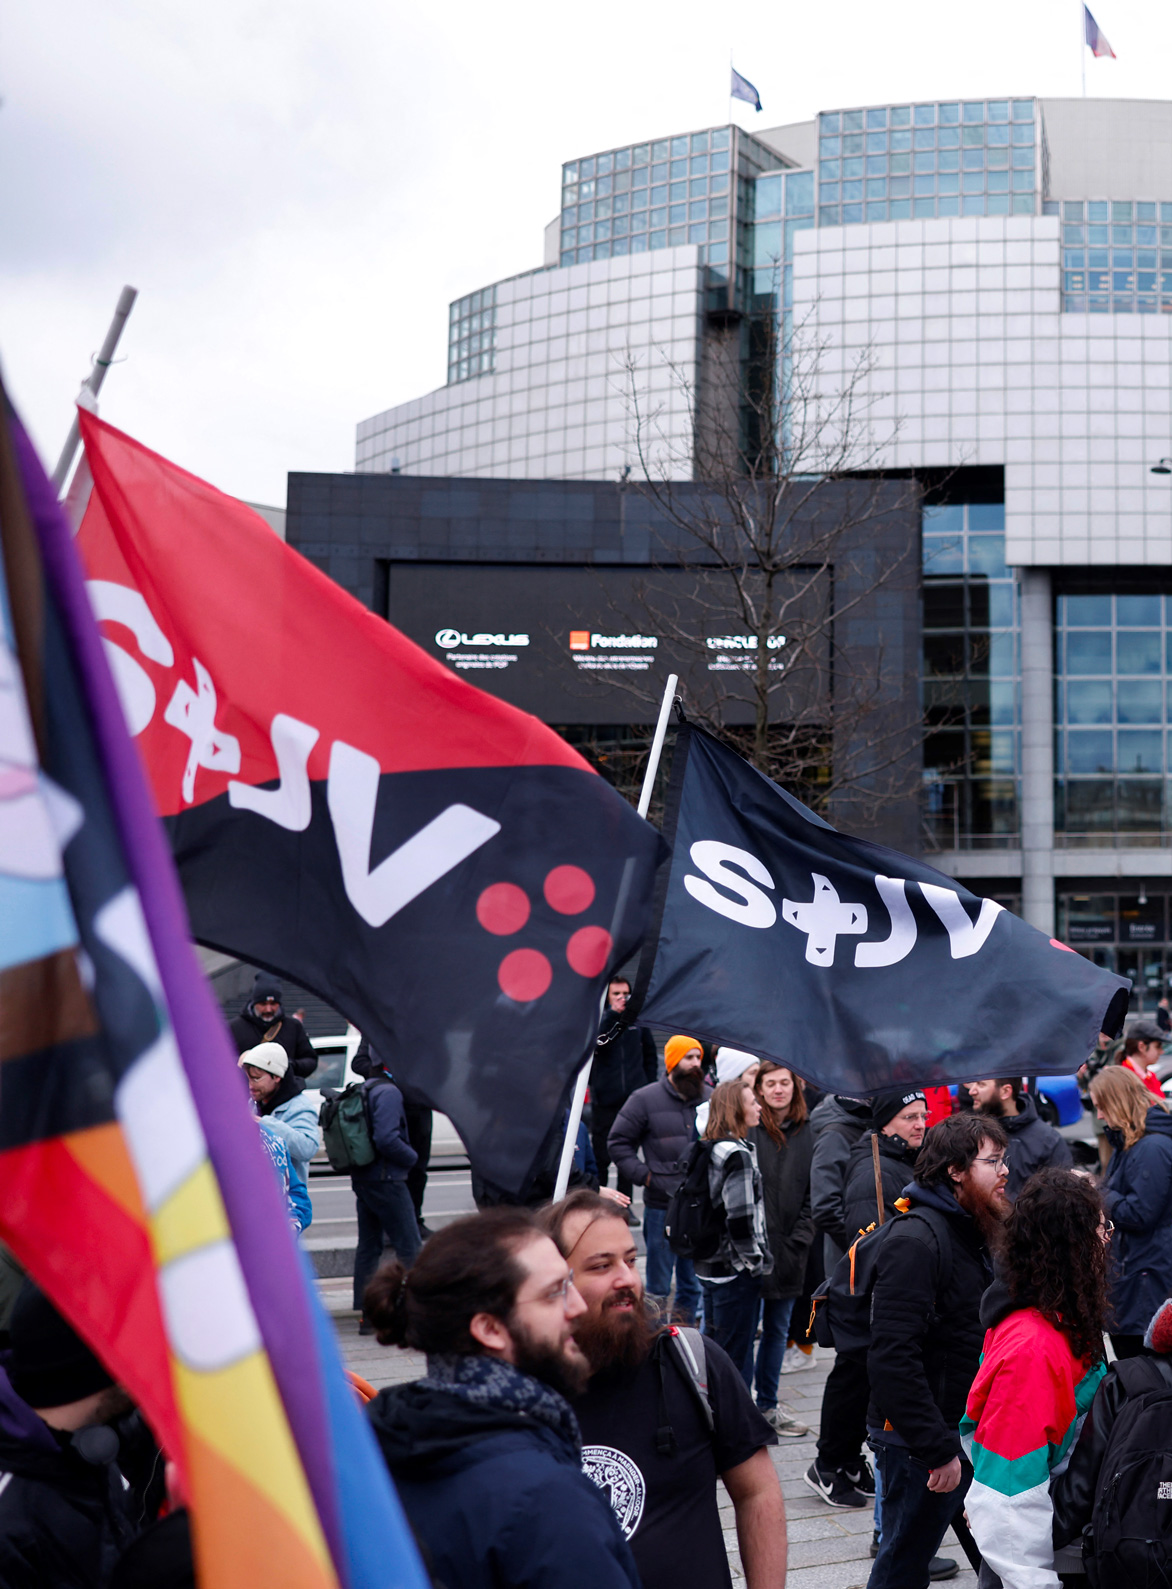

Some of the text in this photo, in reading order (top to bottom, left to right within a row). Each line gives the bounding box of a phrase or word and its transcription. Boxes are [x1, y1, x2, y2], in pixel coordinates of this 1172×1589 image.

[461, 633, 530, 646] LEXUS
[591, 634, 658, 648] Fondation
[582, 1449, 611, 1458] MMENÇA
